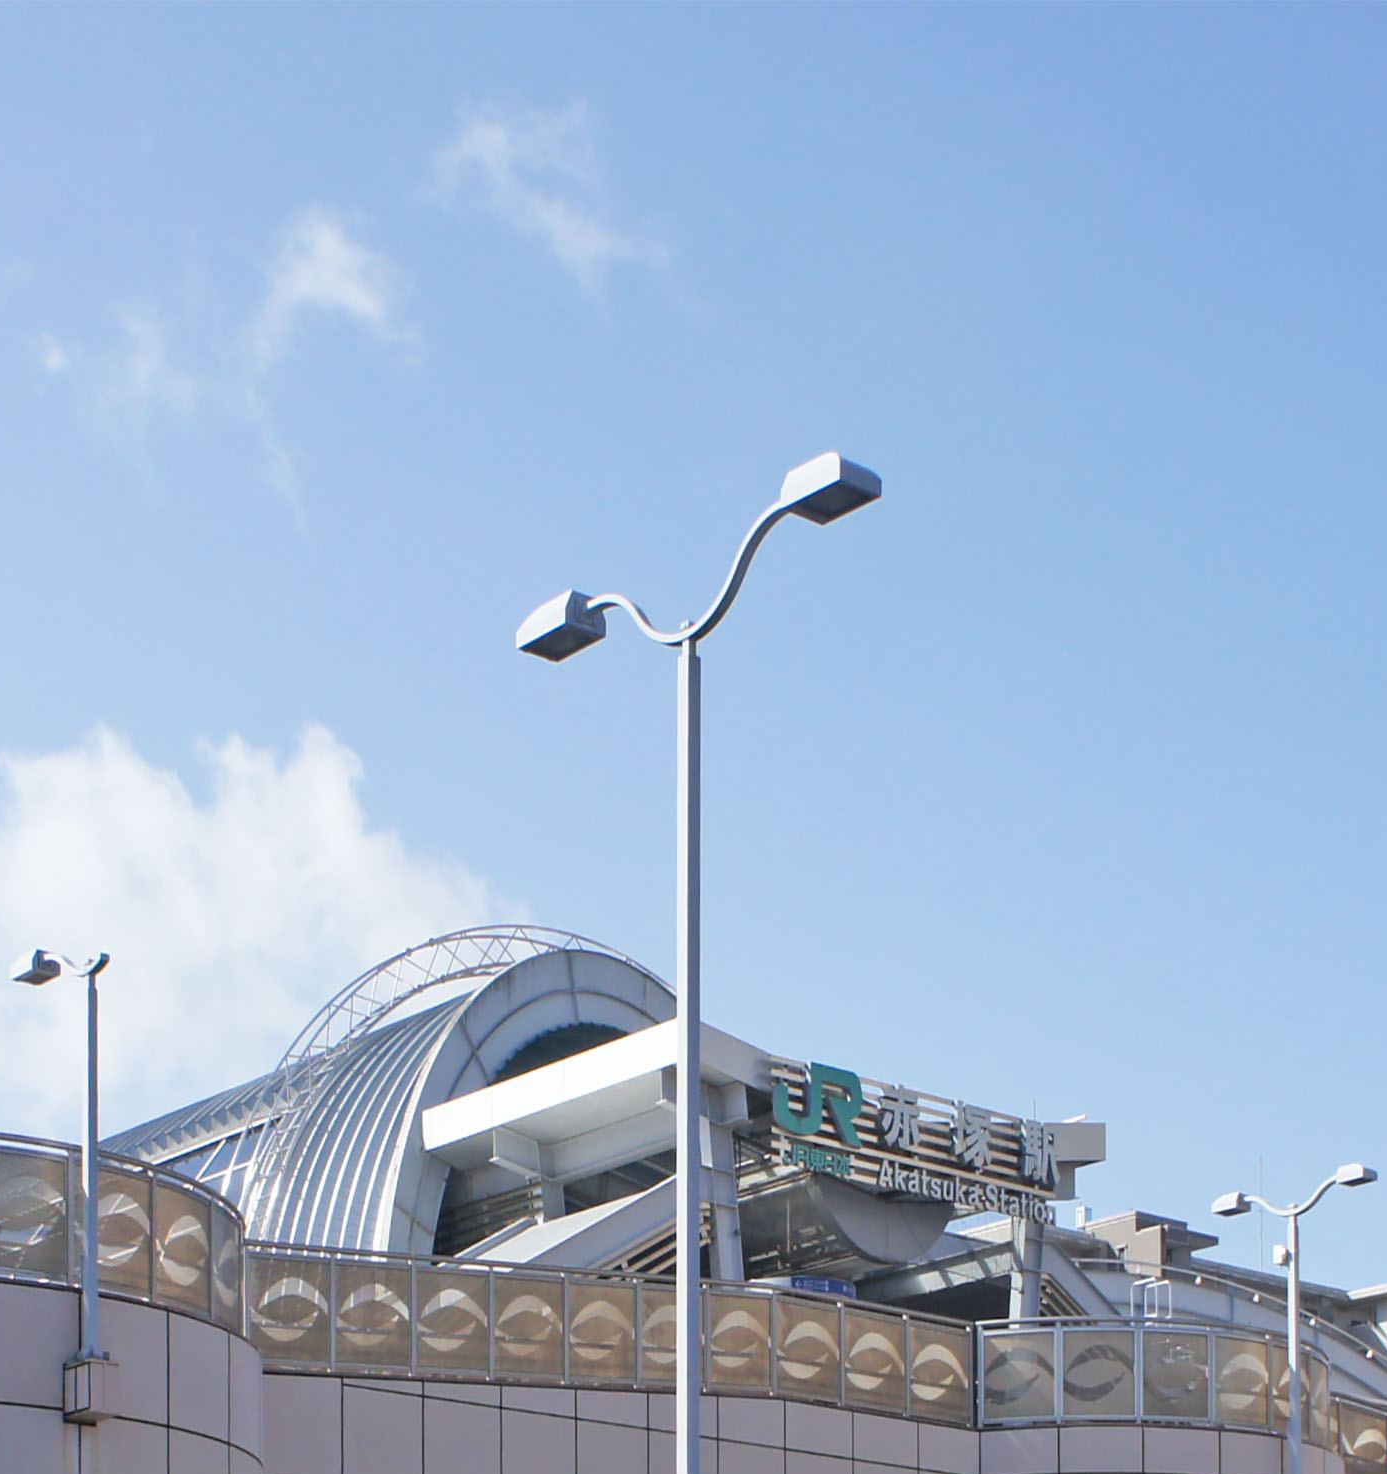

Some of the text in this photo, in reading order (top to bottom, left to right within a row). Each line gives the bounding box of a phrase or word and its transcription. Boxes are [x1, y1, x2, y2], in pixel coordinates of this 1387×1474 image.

[772, 1061, 863, 1147] JR
[879, 1084, 1060, 1190] 赤塚駅
[783, 1143, 852, 1176] JR東日本
[878, 1160, 1057, 1226] Akatsuka Station
